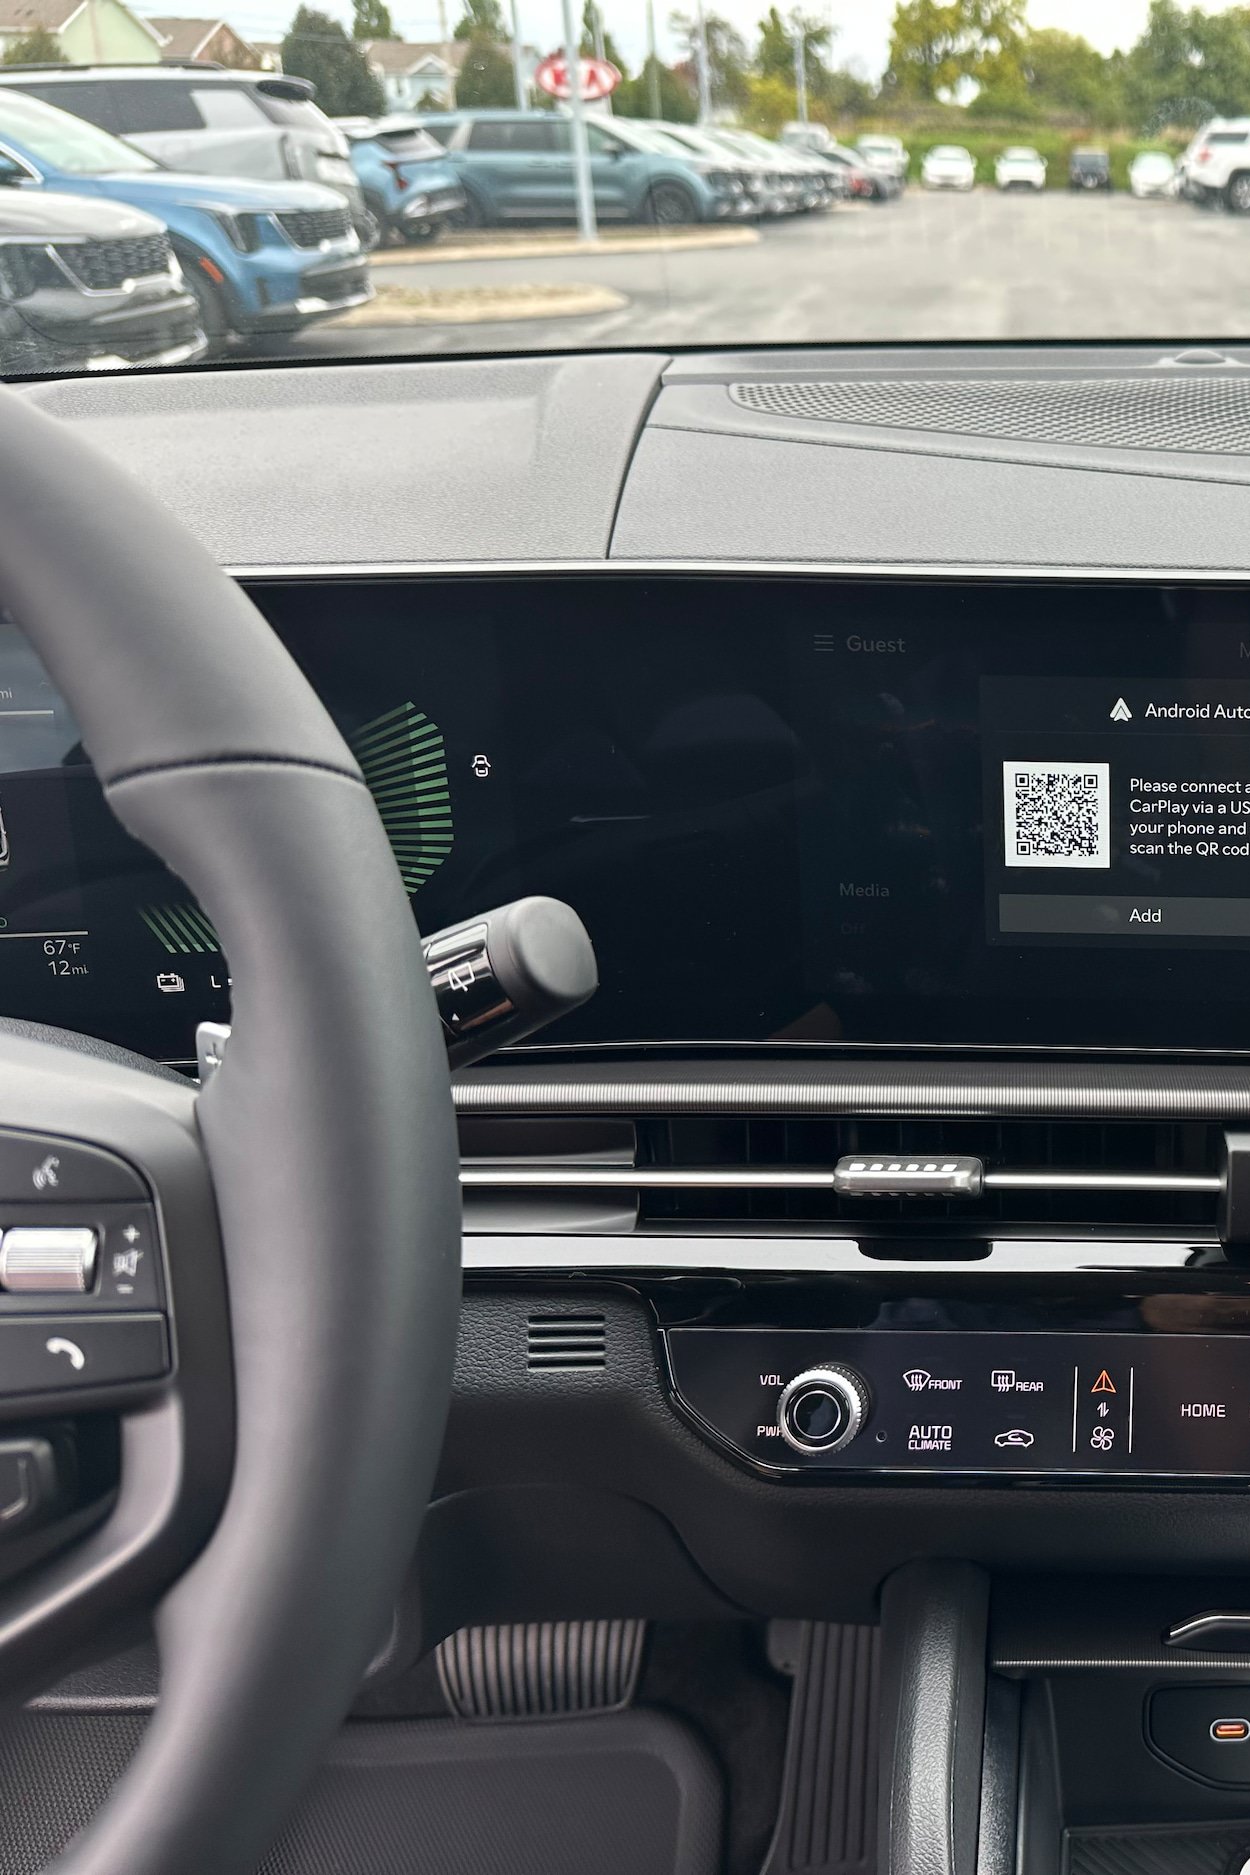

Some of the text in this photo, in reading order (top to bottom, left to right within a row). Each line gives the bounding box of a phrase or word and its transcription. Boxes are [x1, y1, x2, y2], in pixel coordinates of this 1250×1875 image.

[846, 635, 907, 654] Guest
[1144, 703, 1210, 719] Android
[1130, 778, 1178, 793] Please
[1180, 781, 1242, 794] connect
[1129, 799, 1190, 817] CarPlay
[1192, 801, 1214, 814] via
[1217, 804, 1227, 815] a
[1129, 823, 1165, 837] your
[1167, 821, 1215, 838] phone
[1217, 822, 1247, 836] and
[1129, 843, 1164, 855] scan
[1167, 841, 1193, 855] the
[1195, 842, 1219, 857] QR
[839, 882, 890, 898] Media
[1129, 908, 1162, 923] Add
[759, 1374, 785, 1386] VOL
[928, 1378, 963, 1390] FRONT
[1015, 1381, 1044, 1392] REAR
[1181, 1403, 1226, 1418] HOME
[908, 1425, 953, 1440] AUTO
[908, 1440, 952, 1451] CLIMATE
